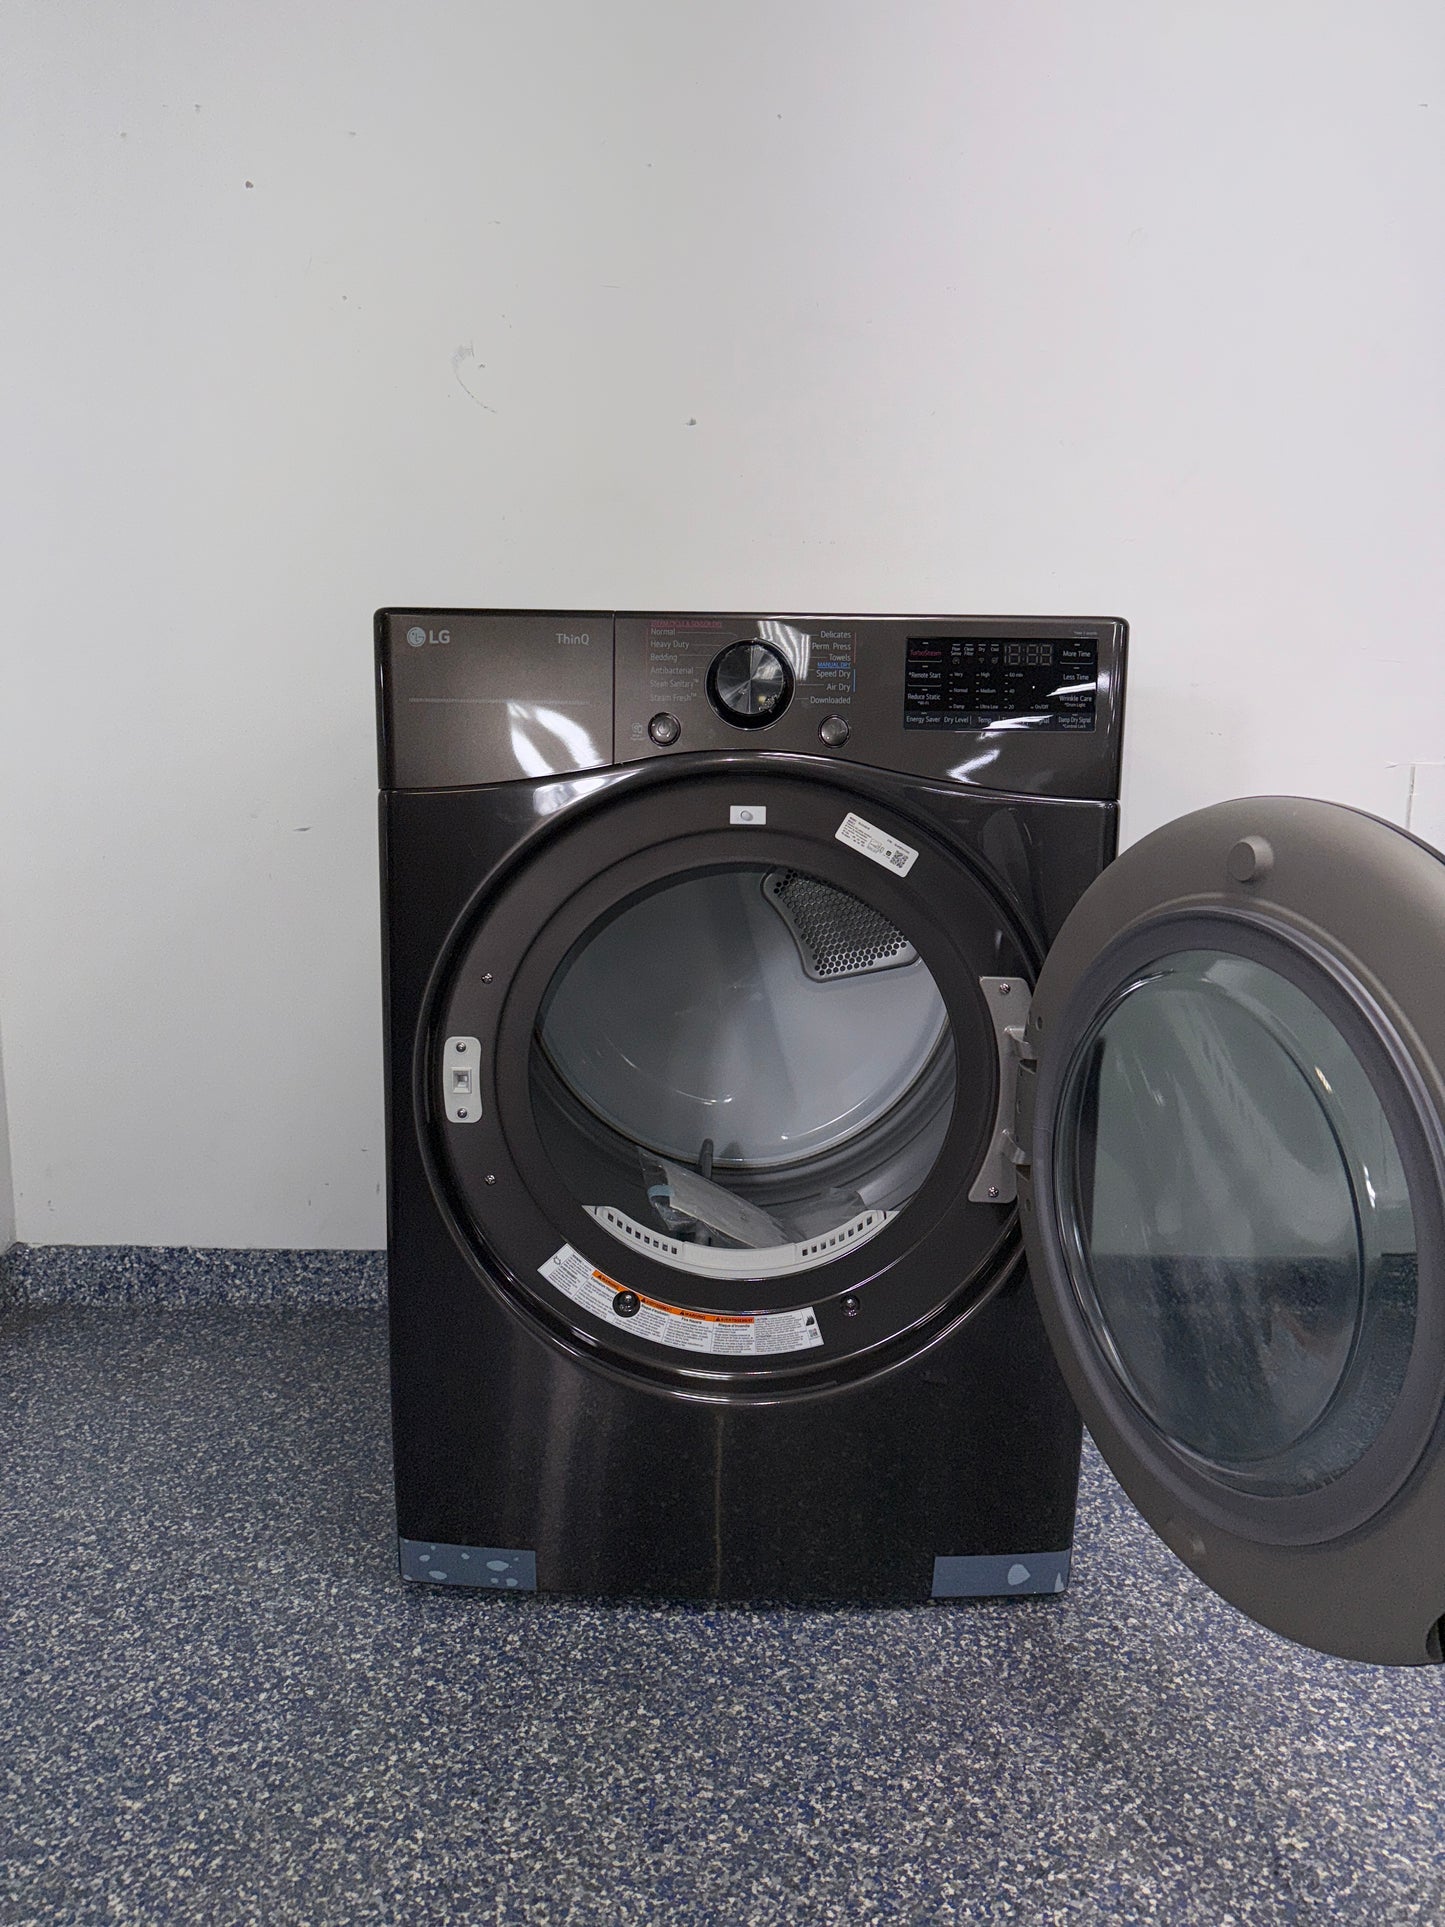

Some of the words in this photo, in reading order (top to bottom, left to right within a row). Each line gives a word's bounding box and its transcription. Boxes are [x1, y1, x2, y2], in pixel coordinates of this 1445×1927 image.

[651, 628, 675, 636] Normal
[820, 630, 851, 639] Delicates
[429, 630, 450, 644] LG
[556, 633, 590, 646] ThinQ
[651, 640, 671, 649] Heavy
[673, 641, 690, 650] Duty
[832, 643, 851, 651] Press
[650, 652, 678, 662] Bedding
[829, 653, 851, 662] Towels
[650, 666, 694, 675] Antibacterial
[816, 669, 837, 679] Speed
[838, 670, 851, 679] Dry
[929, 671, 941, 679] Start
[826, 683, 837, 691] Air
[838, 683, 851, 692] Dry
[810, 695, 851, 704] Downloaded
[906, 715, 925, 724] Energy
[926, 715, 941, 723] Saver
[943, 716, 954, 724] Dry
[954, 715, 969, 723] Level
[1070, 716, 1078, 724] Dry
